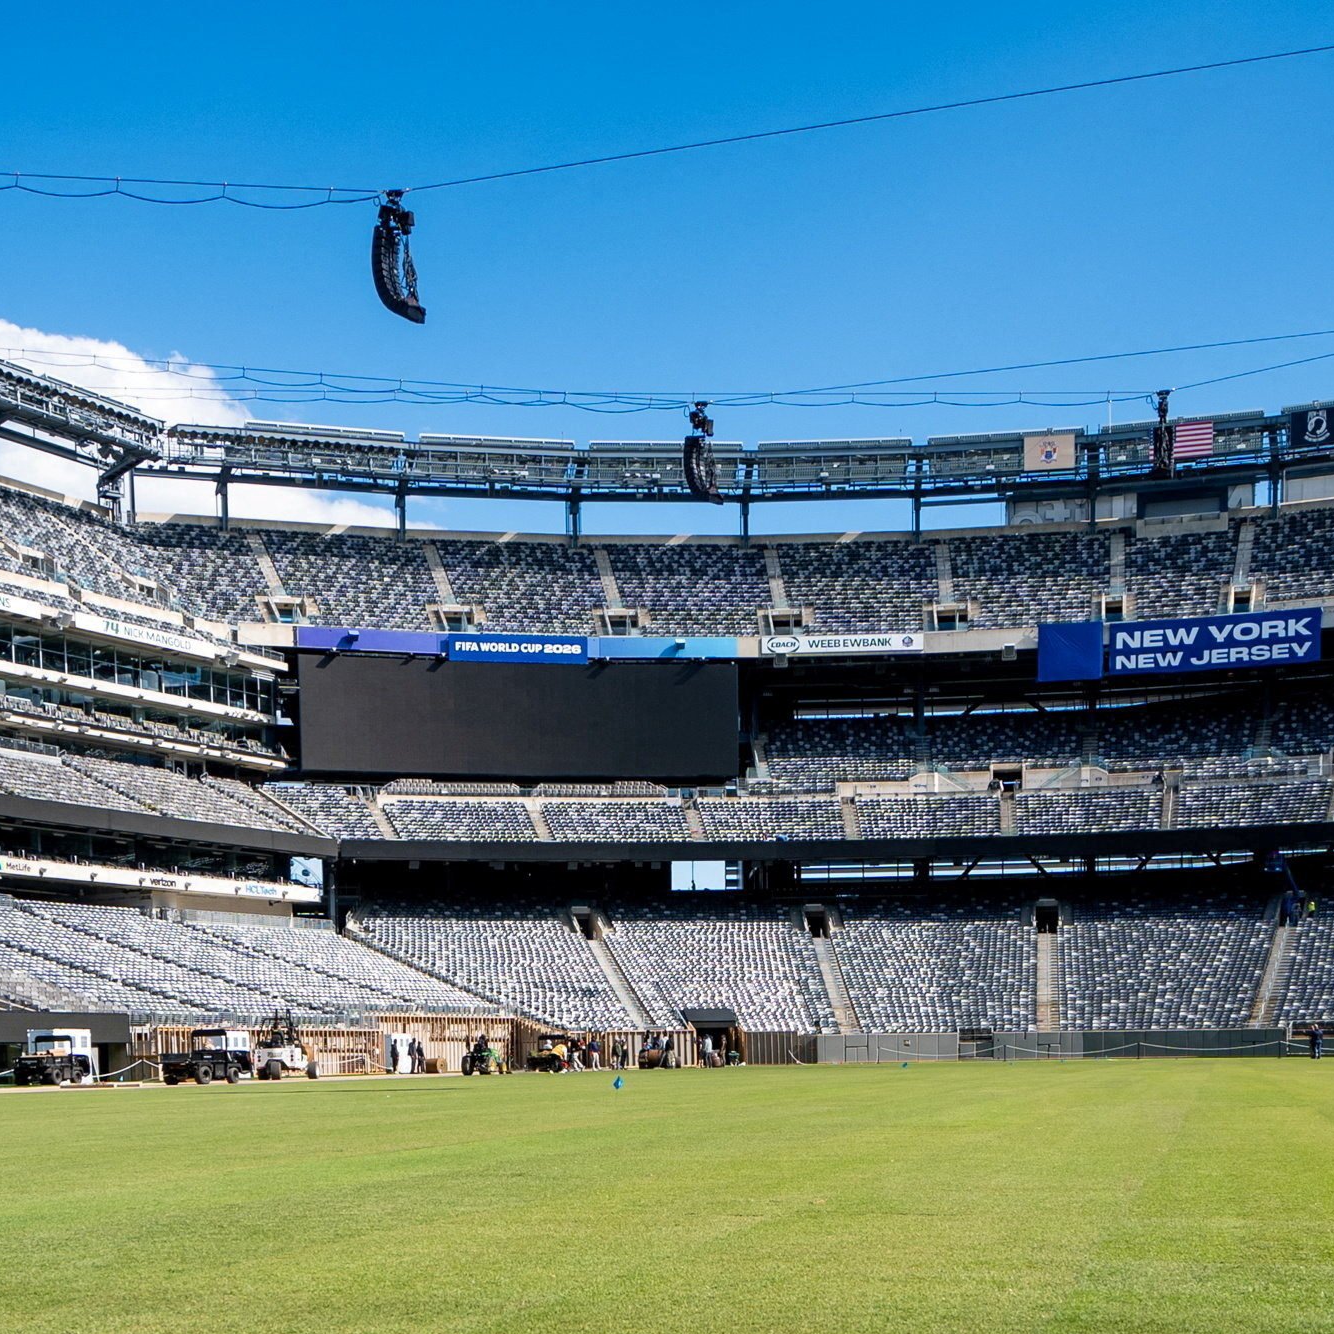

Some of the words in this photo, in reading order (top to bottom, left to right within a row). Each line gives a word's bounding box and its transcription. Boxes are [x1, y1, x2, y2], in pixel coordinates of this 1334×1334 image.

[102, 620, 120, 635] 74
[123, 625, 144, 640] NICK
[146, 631, 191, 651] MANGOLD
[1115, 626, 1199, 649] NEW
[1207, 617, 1312, 642] YORK
[455, 641, 479, 652] FIFA
[480, 642, 519, 653] WORLD
[520, 643, 542, 653] CUP
[544, 644, 582, 654] 2026
[770, 641, 797, 649] COACH
[808, 639, 841, 648] WEEB
[843, 637, 892, 648] EWBANK
[1115, 651, 1184, 670] NEW
[1190, 641, 1312, 665] JERSEY
[5, 861, 32, 873] MetLife
[149, 876, 177, 888] verizon
[244, 884, 278, 897] HCLTech
